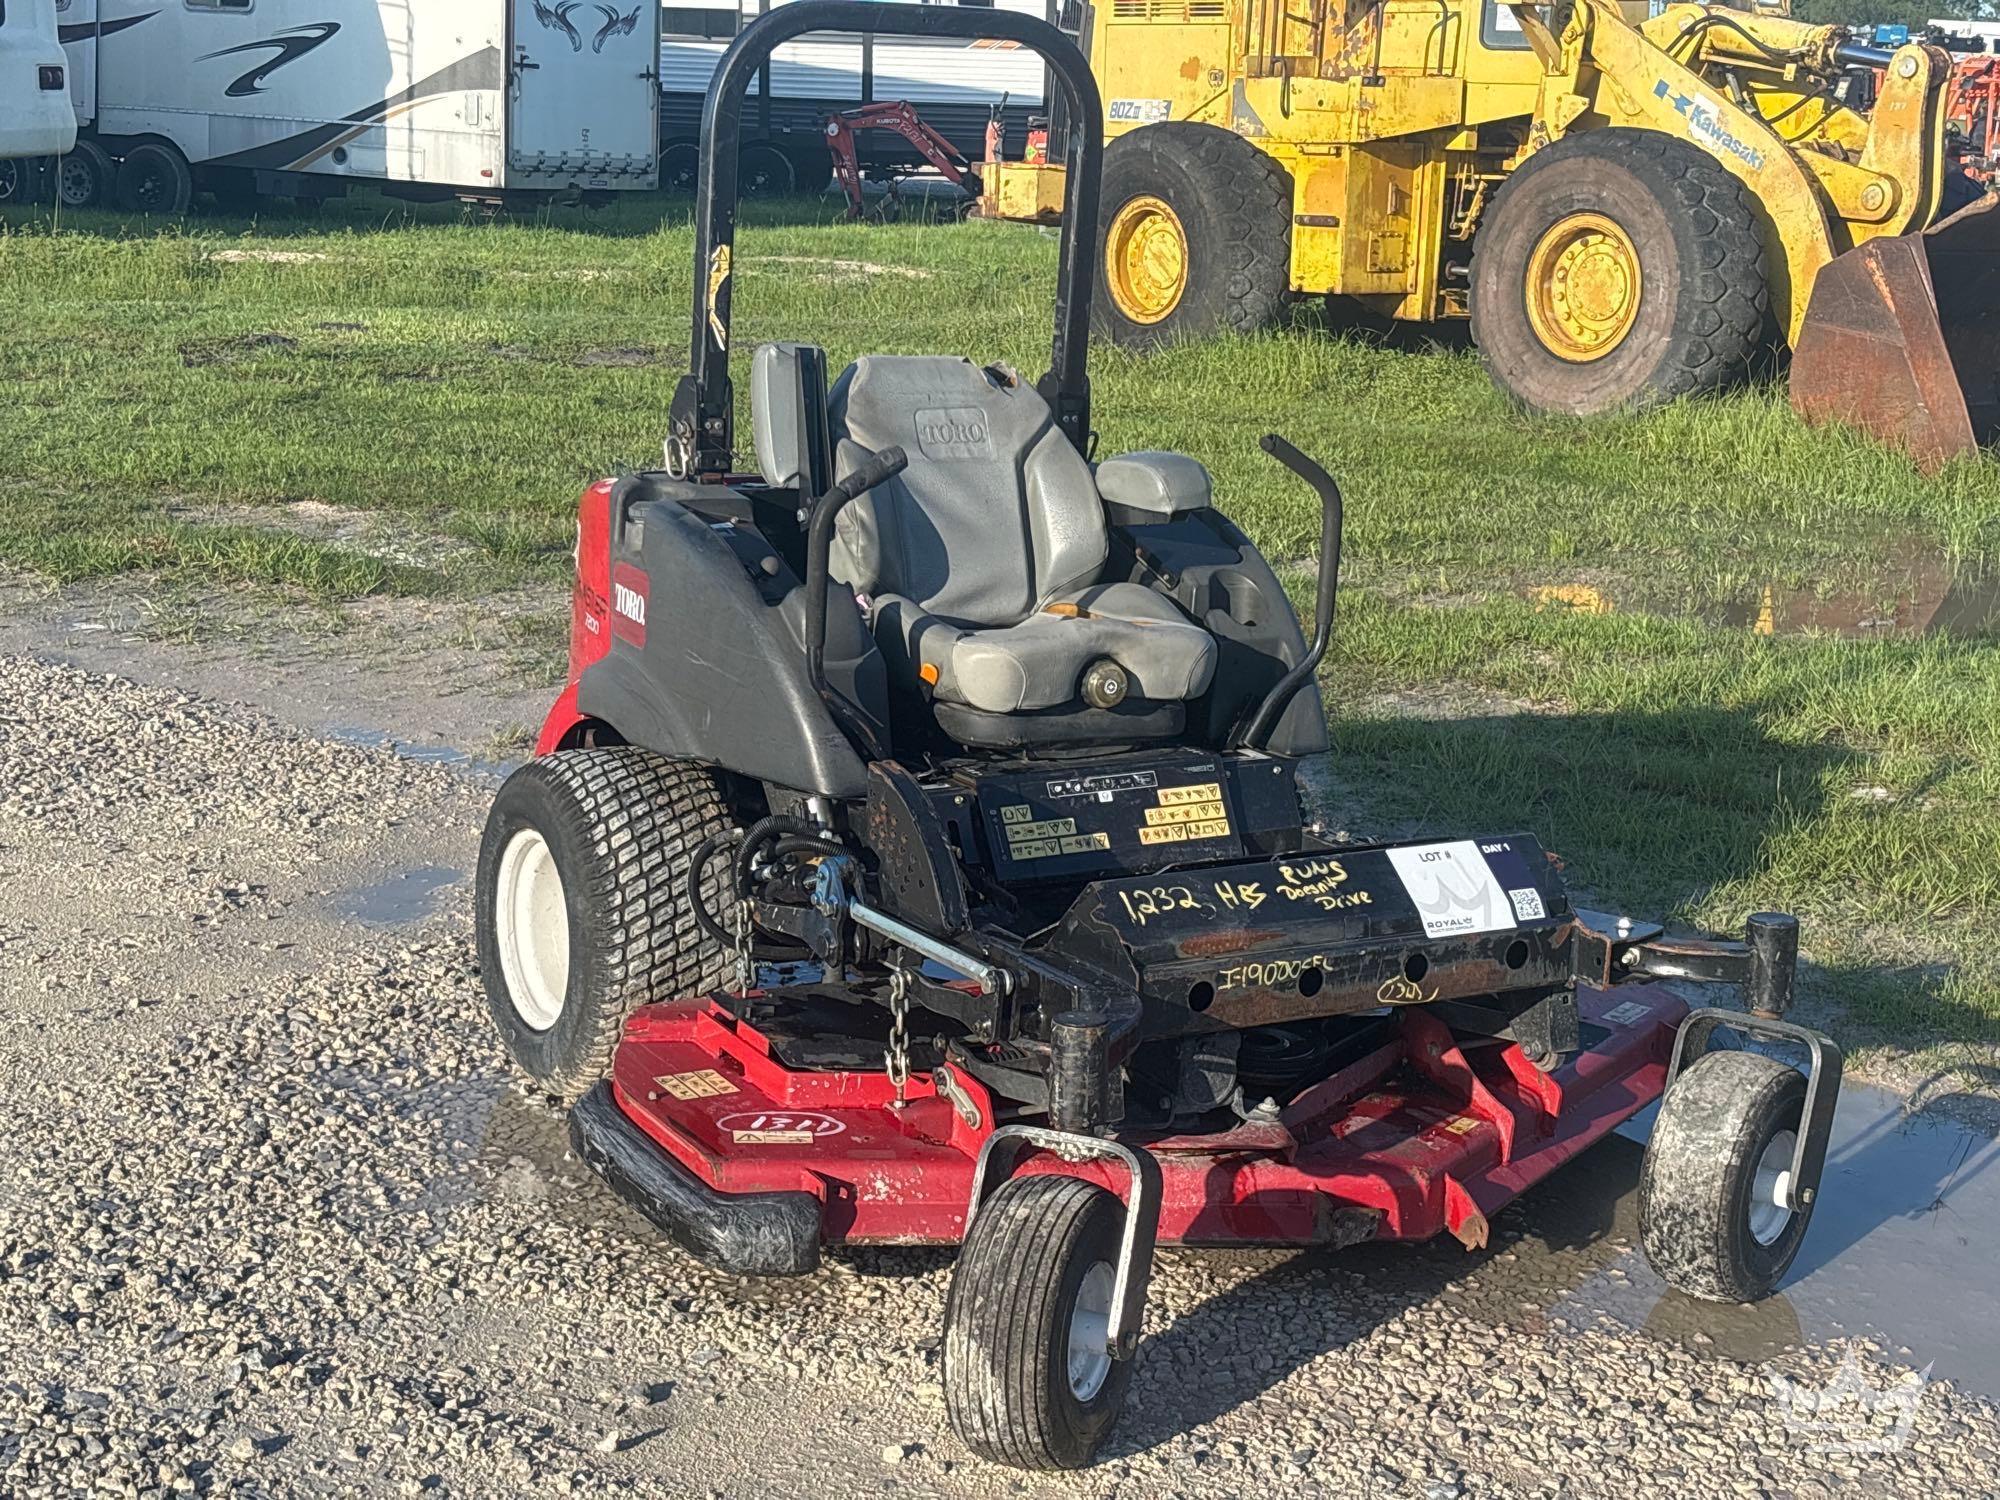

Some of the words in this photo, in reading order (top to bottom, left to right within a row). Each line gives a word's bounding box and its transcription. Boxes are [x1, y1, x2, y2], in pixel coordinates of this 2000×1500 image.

[1690, 104, 1767, 170] Kawasaki
[1481, 843, 1503, 854] DAY
[1503, 842, 1511, 852] 1
[1418, 851, 1443, 863] LOT
[1118, 886, 1202, 926] 1,232
[1313, 890, 1373, 911] Drive
[1426, 918, 1464, 929] ROYAL
